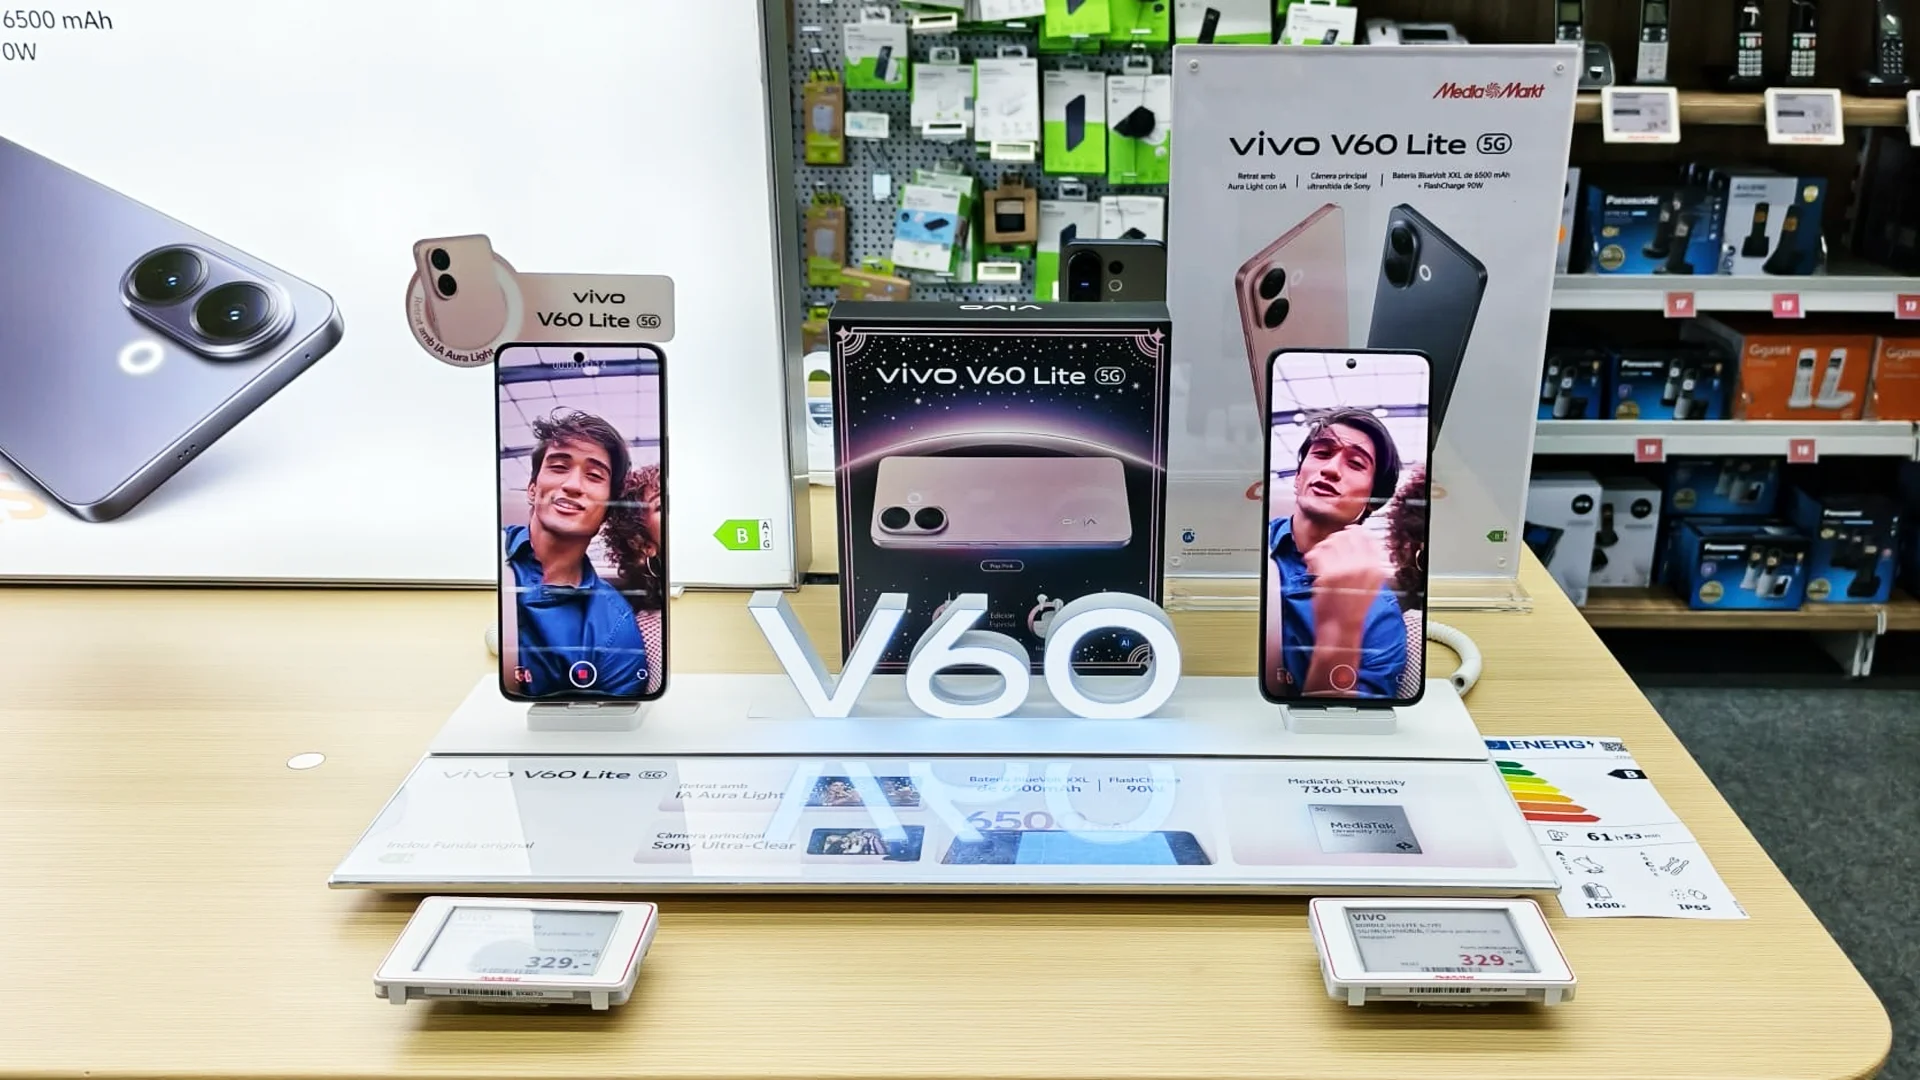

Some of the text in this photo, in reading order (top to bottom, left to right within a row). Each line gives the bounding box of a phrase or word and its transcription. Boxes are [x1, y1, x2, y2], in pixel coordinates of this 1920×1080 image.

[3, 10, 113, 30] 6500 mAh
[1229, 131, 1509, 156] vivo V60 Lite 5G
[1338, 172, 1367, 181] principal
[1245, 183, 1264, 191] Light
[1343, 182, 1352, 190] de
[1353, 182, 1371, 192] Sony
[1423, 182, 1465, 190] FlashCharge
[573, 289, 625, 304] vivo
[537, 311, 659, 329] V60 Lite 5G
[434, 343, 445, 355] IA
[445, 350, 469, 362] Aura
[470, 348, 494, 362] Light
[876, 362, 1123, 385] vivo V60 Lite 5G
[762, 522, 769, 530] A
[736, 528, 749, 544] B
[763, 540, 770, 548] G
[748, 591, 1182, 719] V60
[1510, 740, 1585, 750] ENERG
[442, 769, 513, 779] vivo
[524, 770, 575, 779] V60
[582, 770, 631, 779] Lite
[1624, 770, 1639, 779] B
[1346, 778, 1406, 787] Dimensity
[674, 790, 785, 801] IA Aura Light
[1300, 786, 1398, 795] 7360-Turbo
[709, 831, 766, 842] principal
[1586, 832, 1613, 842] 61
[651, 841, 797, 852] Sony Ultra-Clear
[1677, 903, 1712, 912] IP65
[1352, 913, 1386, 921] VIVO
